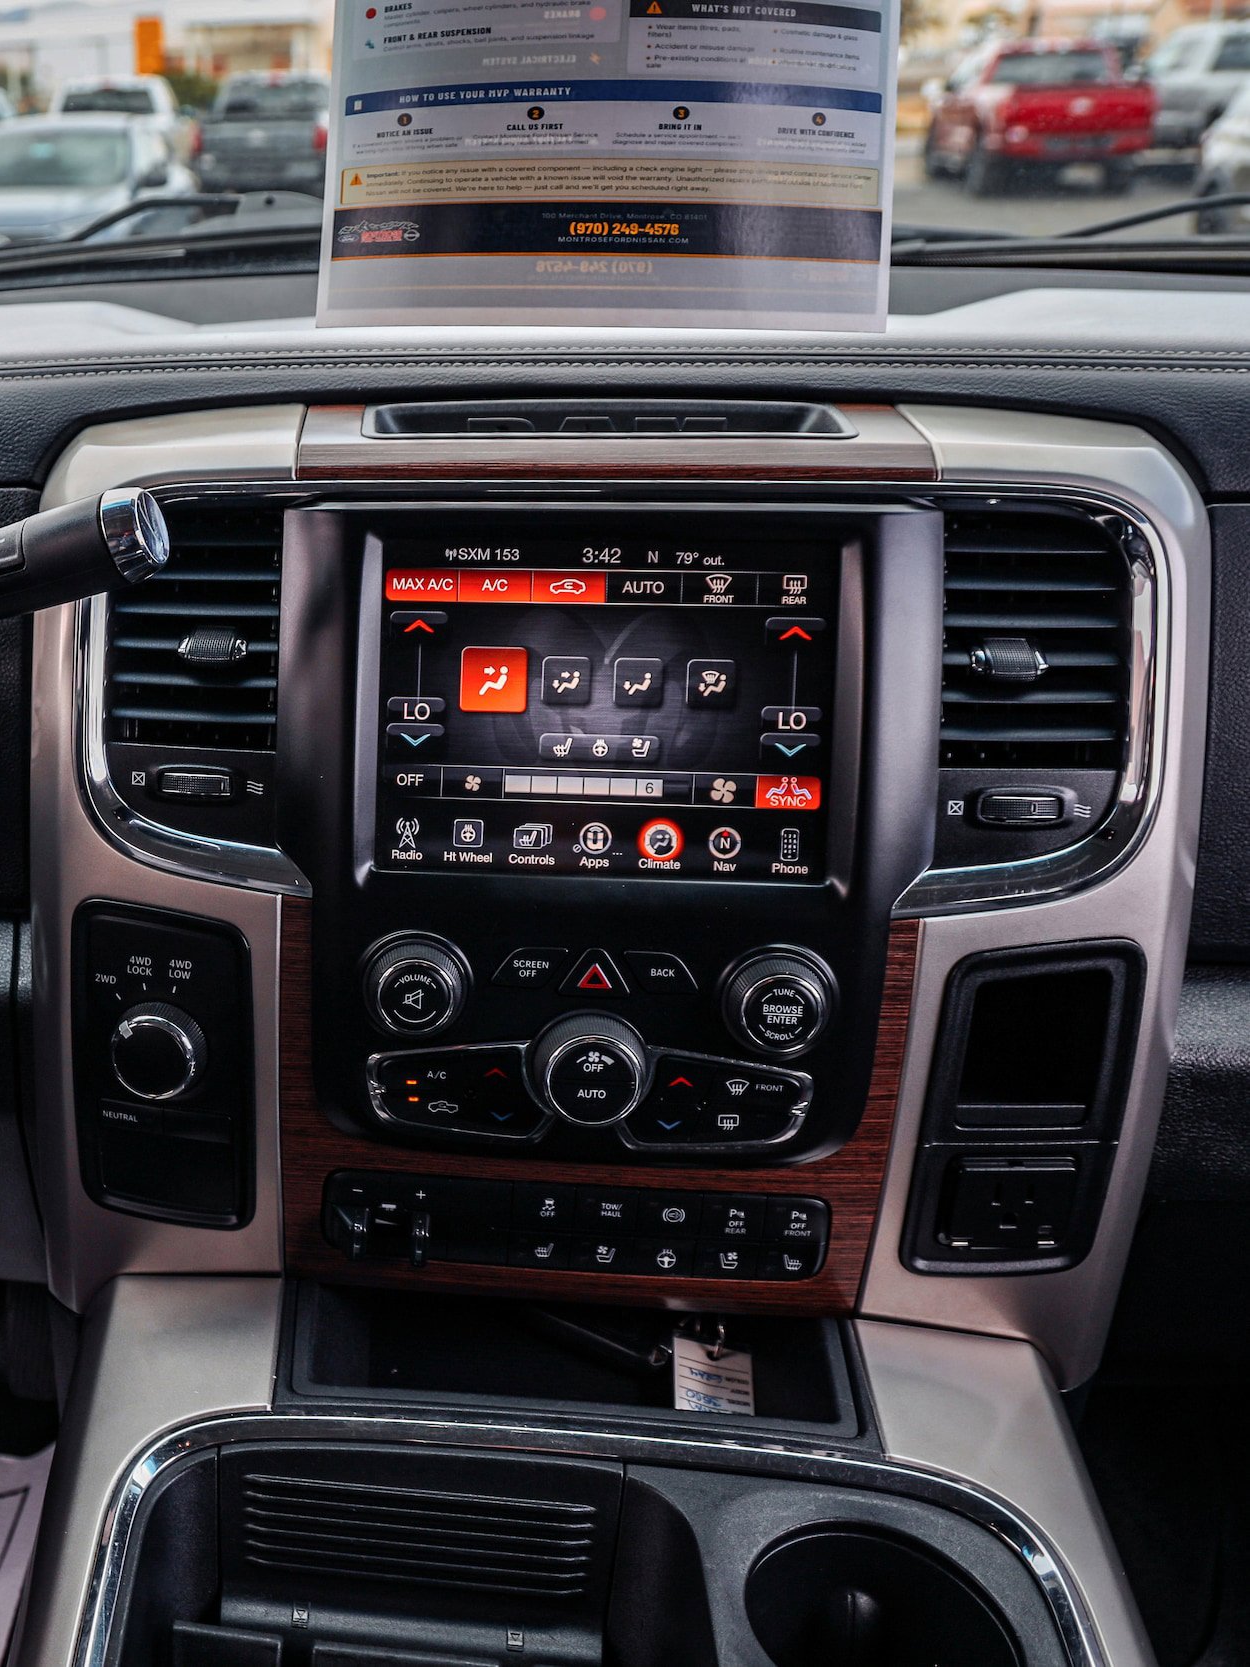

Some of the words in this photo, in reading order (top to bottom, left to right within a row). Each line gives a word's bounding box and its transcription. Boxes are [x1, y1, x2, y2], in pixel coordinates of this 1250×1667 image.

[384, 2, 413, 13] BRAKES
[692, 4, 730, 13] WHAT'S
[732, 5, 752, 14] NOT
[755, 6, 797, 17] COVERED
[383, 34, 406, 44] FRONT
[409, 33, 415, 41] &
[417, 31, 438, 40] REAR
[440, 27, 492, 38] SUSPENSION
[399, 95, 420, 104] HOW
[438, 92, 456, 100] USE
[460, 90, 486, 99] YOUR
[488, 89, 510, 98] MVP
[513, 87, 571, 97] WARRANTY
[532, 109, 540, 118] 2
[678, 109, 685, 118] 3
[413, 128, 434, 136] ISSUE
[777, 127, 797, 135] DRIVE
[800, 128, 816, 136] WITH
[818, 130, 856, 139] CONFIDENCE
[506, 184, 522, 192] help
[600, 184, 614, 192] get
[558, 212, 598, 220] Merchant
[569, 221, 610, 236] (970)
[612, 222, 680, 236] 249-4576
[458, 548, 490, 560] SXM
[494, 548, 520, 560] 153
[582, 547, 622, 564] 3:42
[647, 550, 659, 564] N
[676, 552, 700, 566] 79°
[703, 556, 725, 566] out.
[392, 578, 425, 590] MAX
[426, 578, 454, 590] A/C
[482, 578, 508, 592] A/C
[622, 581, 665, 594] AUTO
[704, 595, 734, 604] FRONT
[782, 596, 807, 604] REAR
[403, 702, 430, 720] LO
[778, 711, 807, 730] LO
[396, 774, 424, 786] OFF
[645, 782, 654, 794] 6
[770, 796, 807, 807] SYNC
[391, 849, 423, 860] Radio
[444, 851, 458, 862] Ht
[459, 851, 493, 863] Wheel
[508, 854, 556, 865] Controls
[580, 856, 610, 869] Apps
[638, 858, 681, 870] Climate
[713, 861, 737, 872] Nav
[771, 862, 808, 874] Phone
[129, 956, 152, 966] 4WD
[169, 960, 192, 970] 4WD
[512, 959, 550, 969] SCREEN
[127, 966, 153, 976] LOCK
[168, 970, 191, 980] LOW
[518, 969, 537, 978] OFF
[650, 968, 676, 978] BACK
[95, 974, 117, 985] 2WD
[398, 974, 432, 985] VOLUME
[772, 988, 796, 998] TUNE
[762, 1004, 804, 1015] BROWSE
[766, 1015, 798, 1026] ENTER
[764, 1030, 795, 1042] SCROLL
[583, 1062, 604, 1074] OFF
[426, 1070, 447, 1080] A/C
[755, 1084, 784, 1092] FRONT
[576, 1088, 607, 1100] AUTO
[102, 1110, 138, 1123] NEUTRAL
[601, 1202, 623, 1211] TOW/
[540, 1210, 556, 1218] OFF
[601, 1210, 622, 1218] HAUL
[728, 1220, 744, 1228] OFF
[790, 1222, 806, 1230] OFF
[725, 1227, 747, 1236] REAR
[784, 1229, 812, 1238] FRONT
